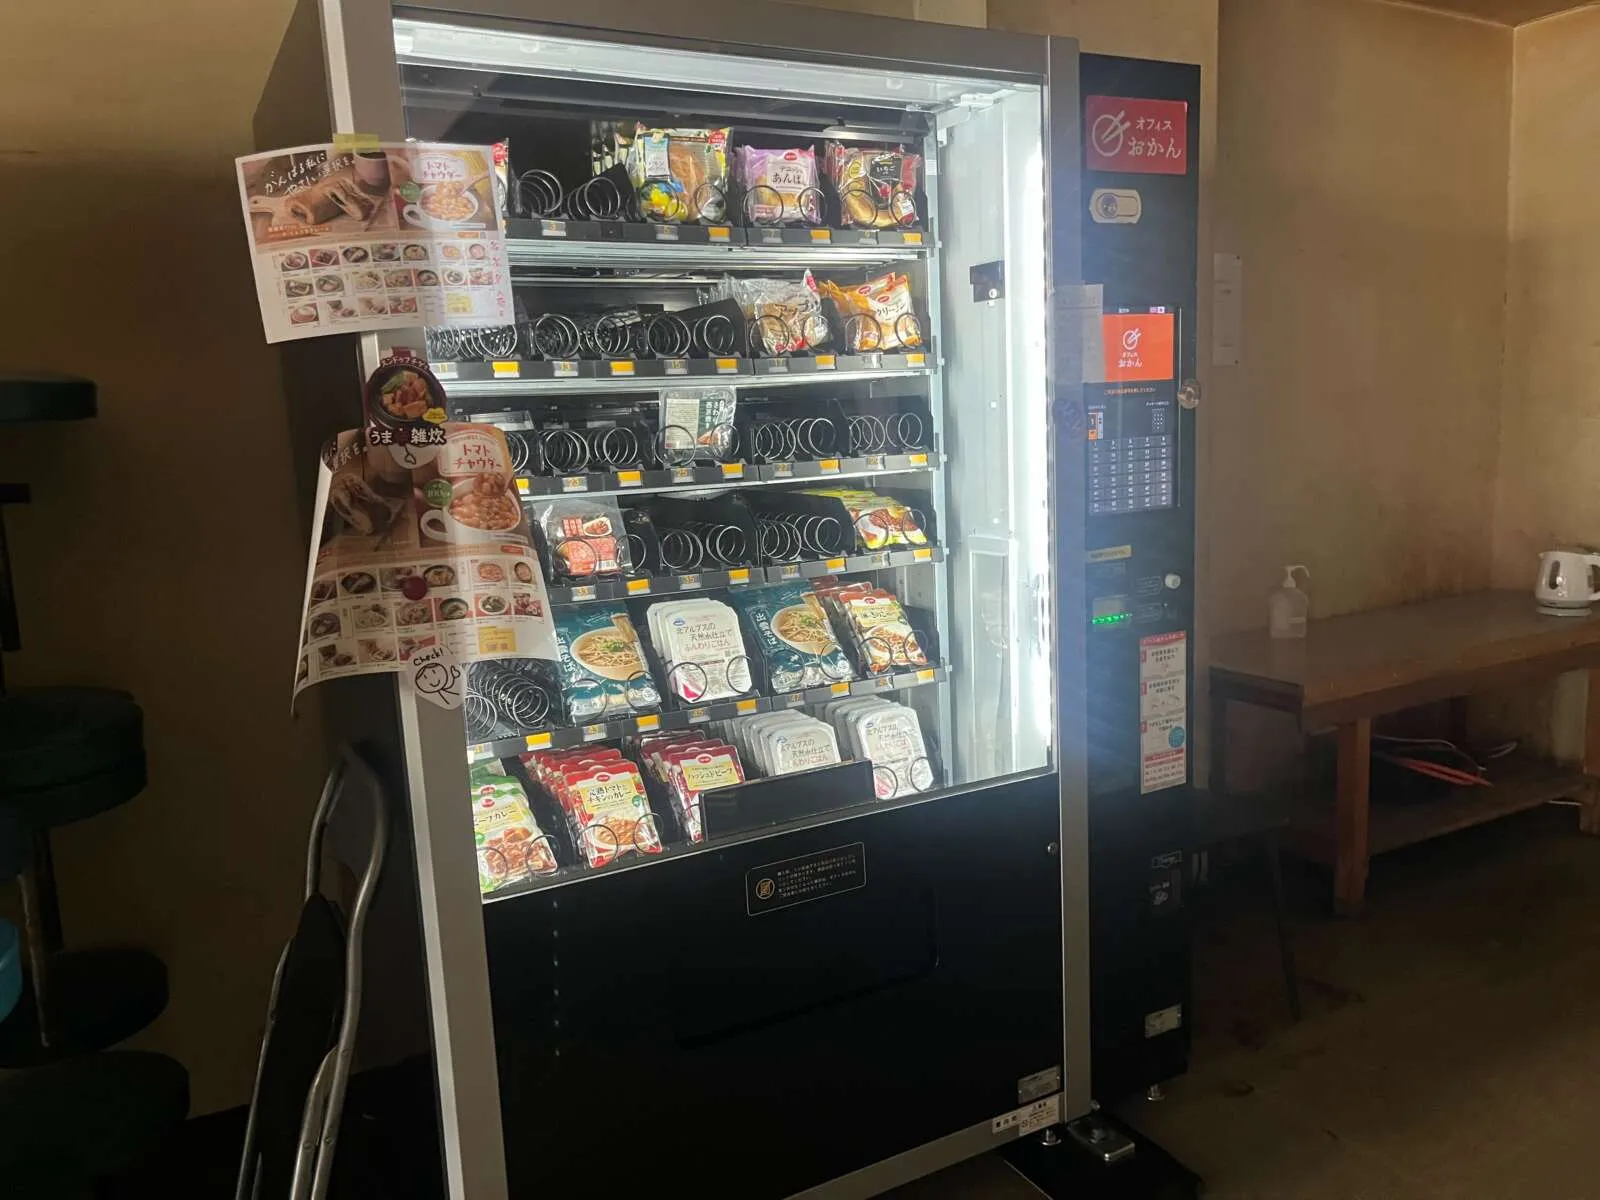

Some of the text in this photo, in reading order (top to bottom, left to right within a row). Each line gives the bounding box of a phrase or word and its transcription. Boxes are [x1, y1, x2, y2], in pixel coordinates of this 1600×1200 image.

[1135, 117, 1173, 131] オフィス
[1128, 137, 1182, 159] おかん
[370, 427, 446, 445] うま雑炊
[463, 443, 491, 456] トマト
[452, 457, 502, 469] チャウダー
[413, 650, 443, 667] Check!
